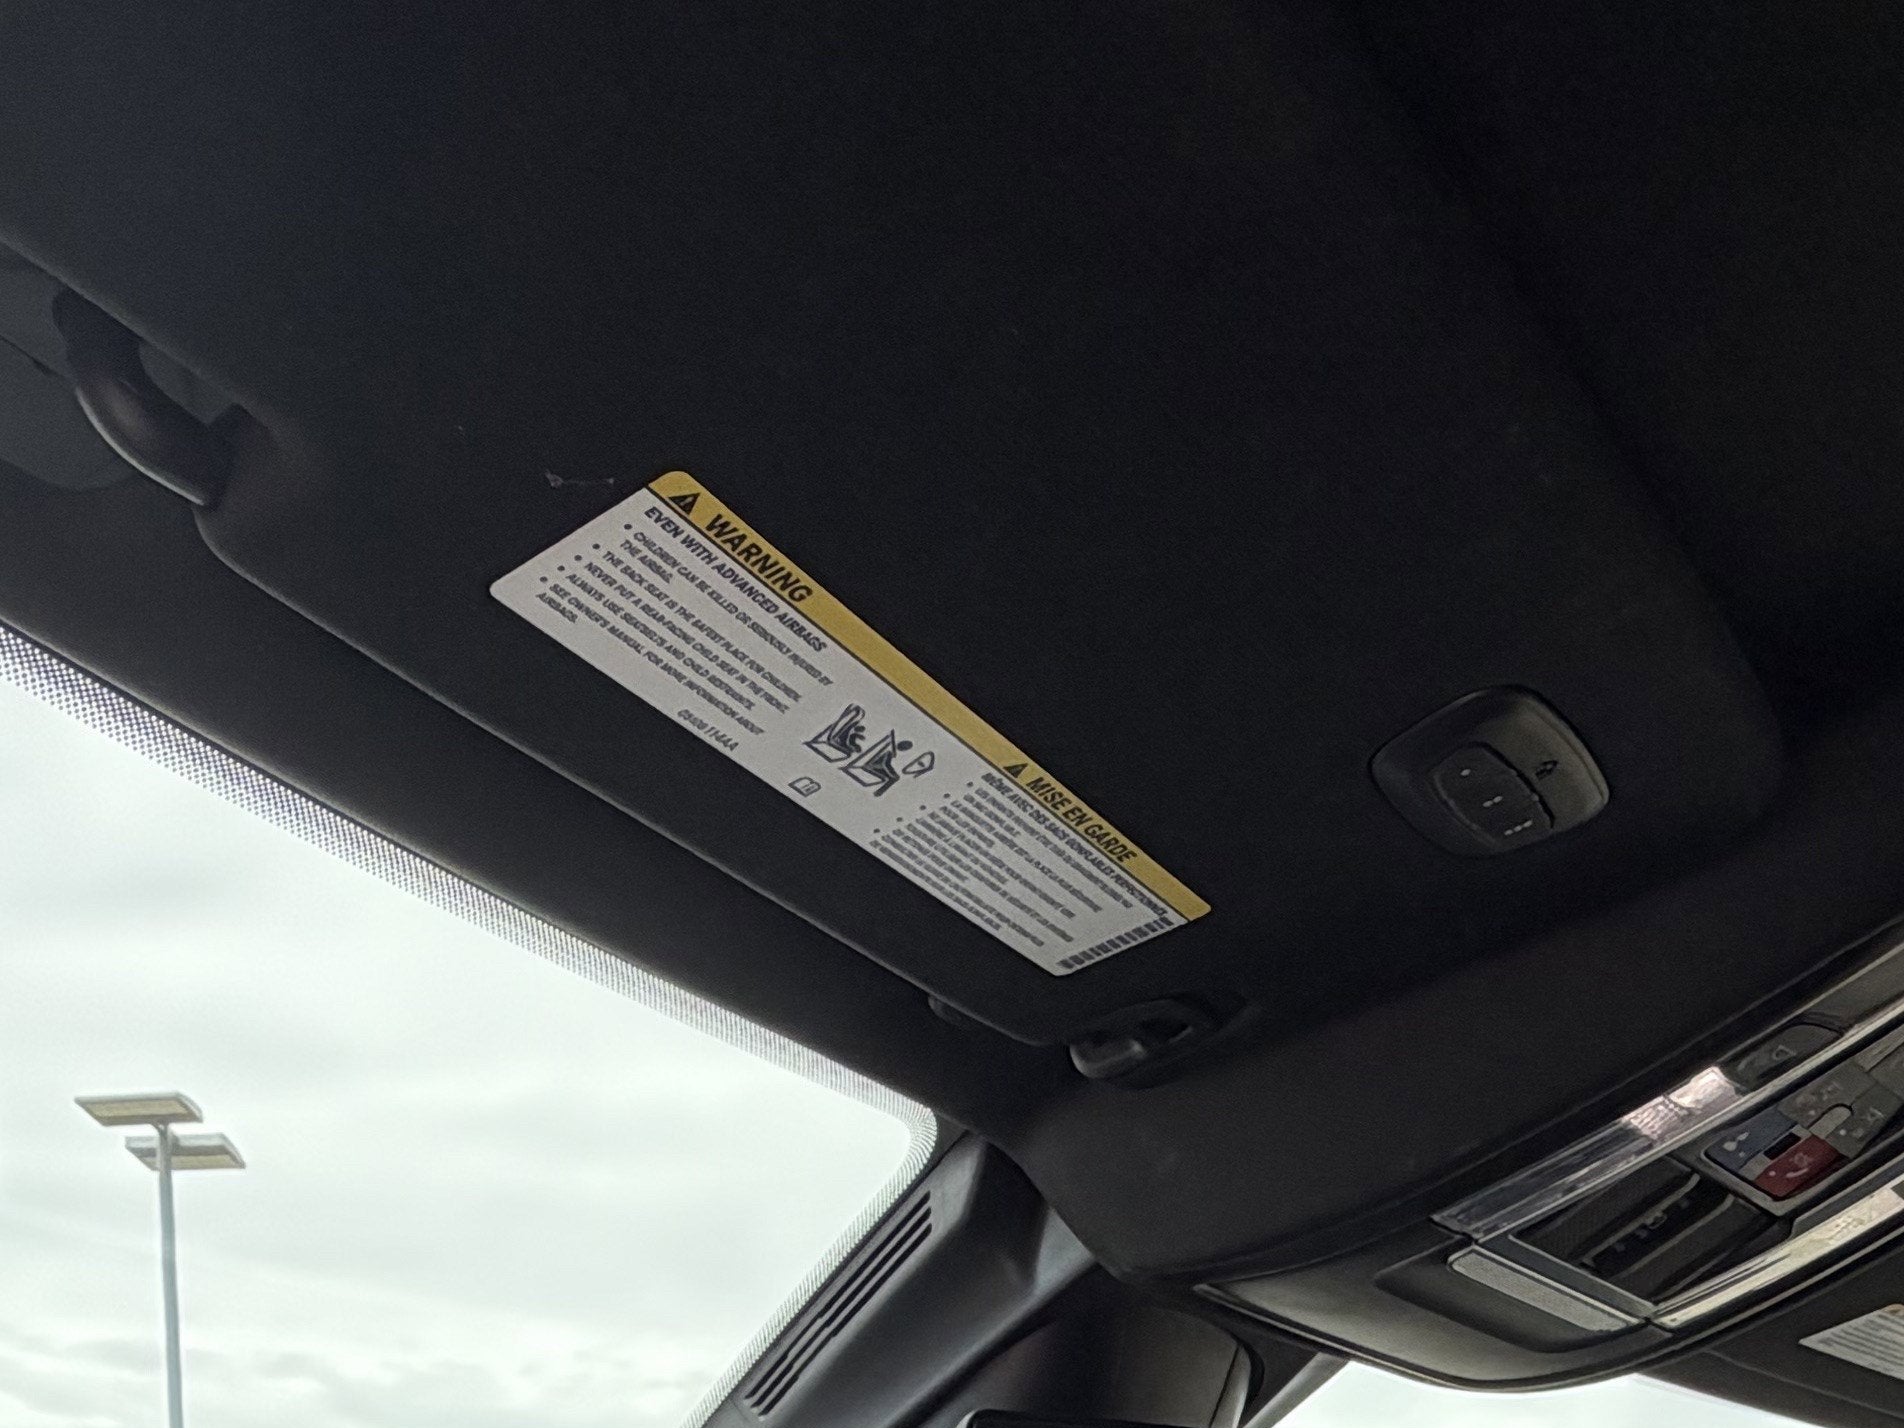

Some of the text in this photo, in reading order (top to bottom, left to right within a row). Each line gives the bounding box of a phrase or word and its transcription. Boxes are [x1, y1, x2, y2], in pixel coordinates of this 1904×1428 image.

[641, 505, 829, 652] EVEN WITH ADVANCED AIRBAGS
[705, 514, 813, 603] WARNING
[1027, 777, 1070, 816] MISE
[1064, 805, 1094, 829] EN
[1085, 820, 1138, 863] GARDE
